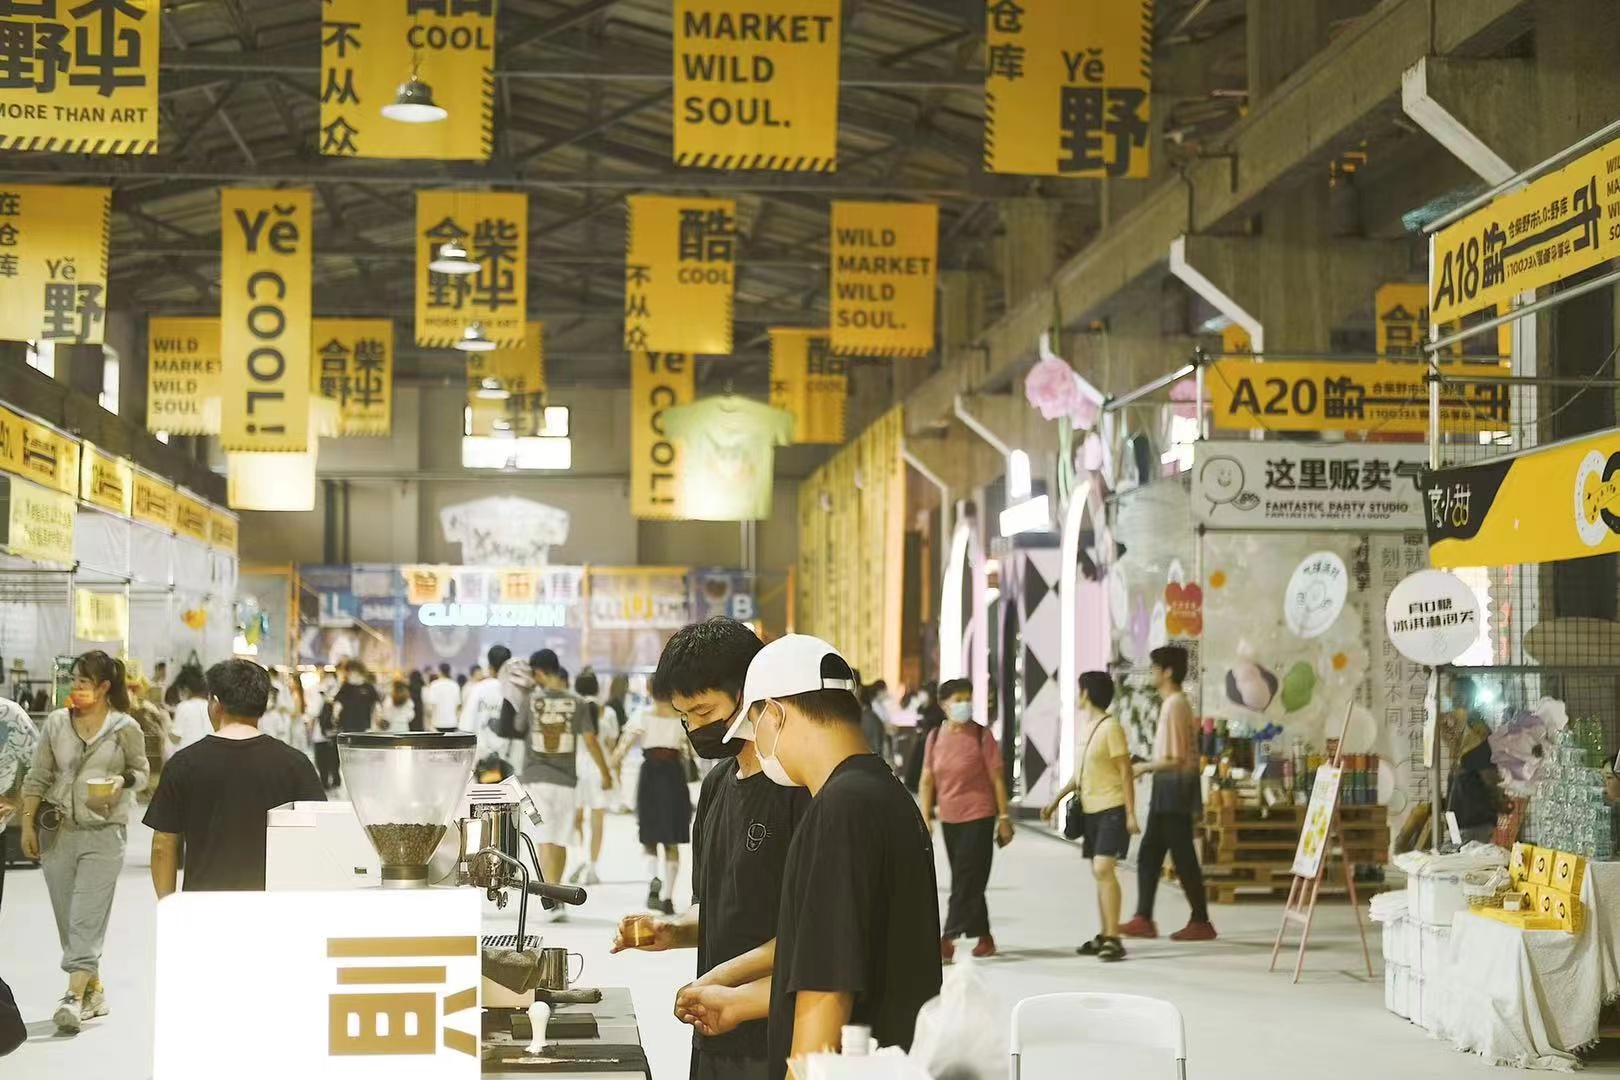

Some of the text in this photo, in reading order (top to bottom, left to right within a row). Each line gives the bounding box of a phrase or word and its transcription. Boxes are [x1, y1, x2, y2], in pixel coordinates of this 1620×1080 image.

[407, 26, 491, 50] COOL
[683, 11, 833, 43] MARKET
[683, 54, 774, 83] WILD
[321, 22, 361, 154] 不从众
[54, 106, 105, 122] THAN
[111, 108, 148, 123] ART
[684, 97, 791, 128] SOUL.
[1057, 86, 1147, 177] 野
[679, 208, 736, 262] 酷
[836, 229, 896, 249] WILD
[679, 268, 732, 284] COOL
[837, 257, 931, 276] MARKET
[1432, 236, 1479, 312] A18
[836, 284, 895, 301] WILD
[42, 282, 104, 344] 野
[837, 310, 907, 330] SOUL.
[153, 337, 198, 352] WILD
[246, 271, 286, 435] COOL!
[152, 380, 198, 394] WILD
[1229, 377, 1318, 416] A20
[1265, 458, 1450, 492] 这里贩卖气
[1265, 502, 1409, 513] FANTASTIC PARTY STUDIO
